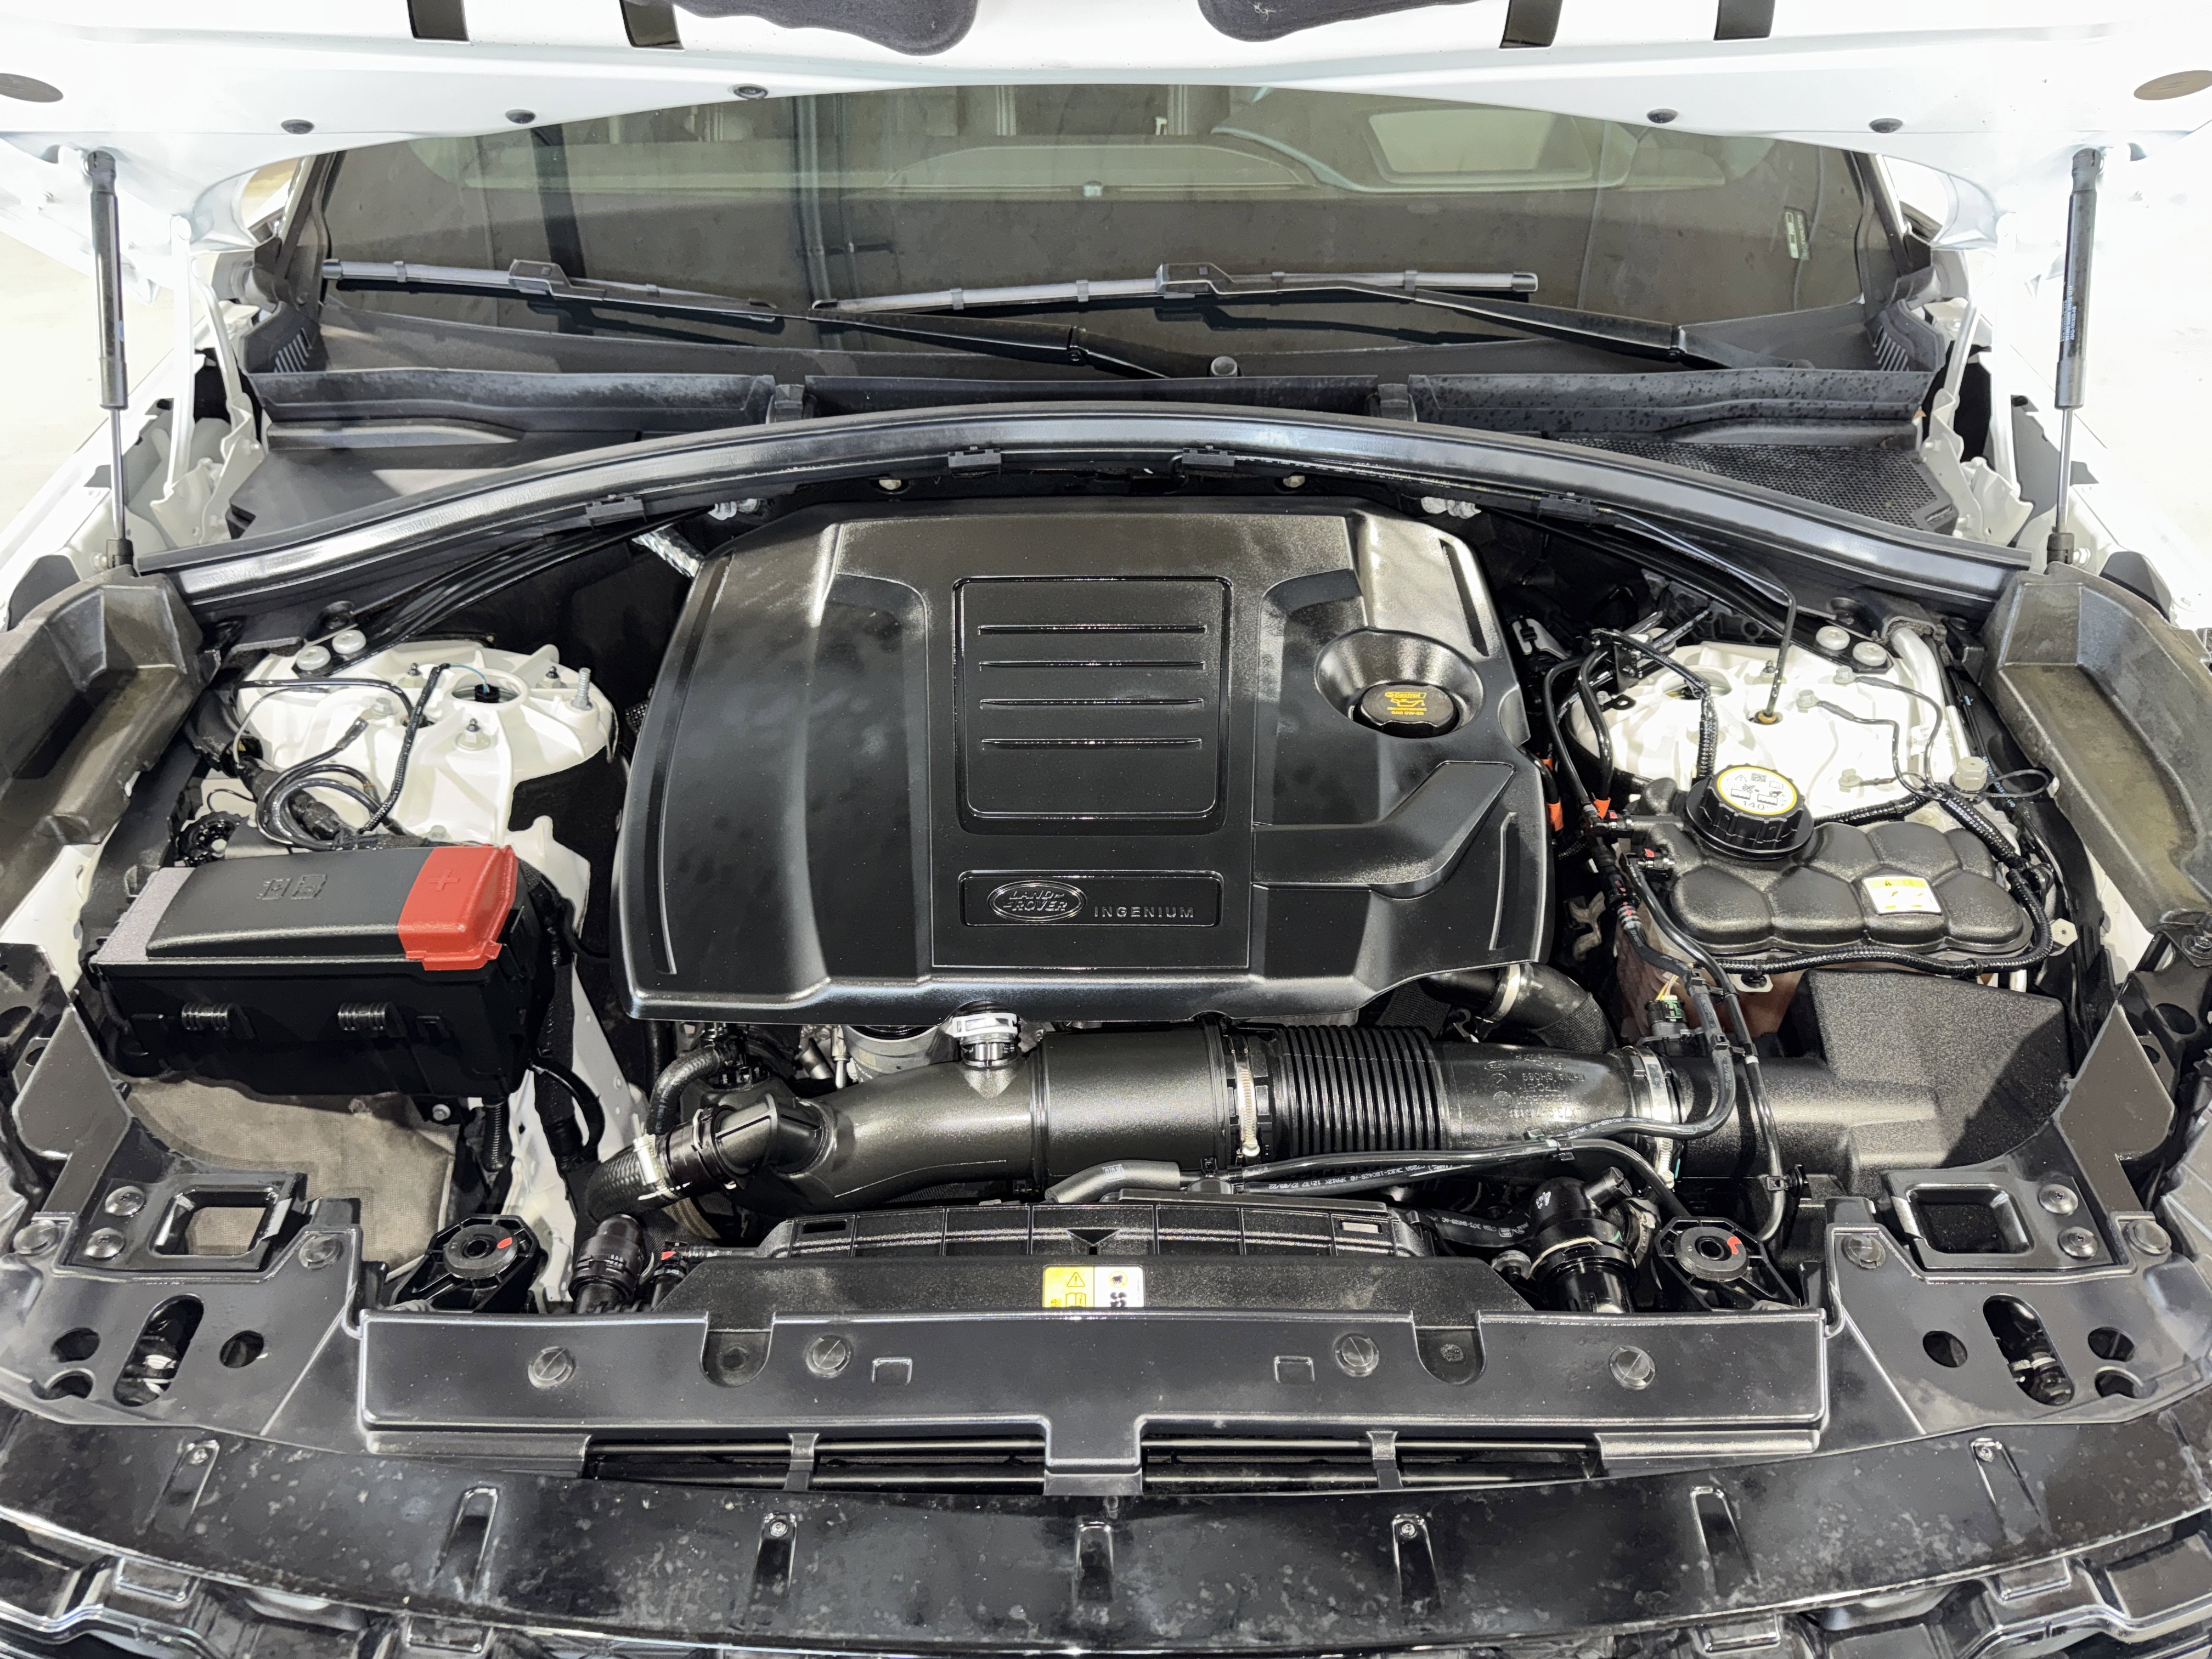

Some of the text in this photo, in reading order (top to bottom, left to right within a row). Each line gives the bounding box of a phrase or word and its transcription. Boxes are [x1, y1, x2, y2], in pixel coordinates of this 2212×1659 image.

[1743, 800, 1765, 810] 140
[1009, 890, 1055, 900] LAND
[1012, 901, 1068, 911] ROVER
[1094, 906, 1194, 918] INGENIUM
